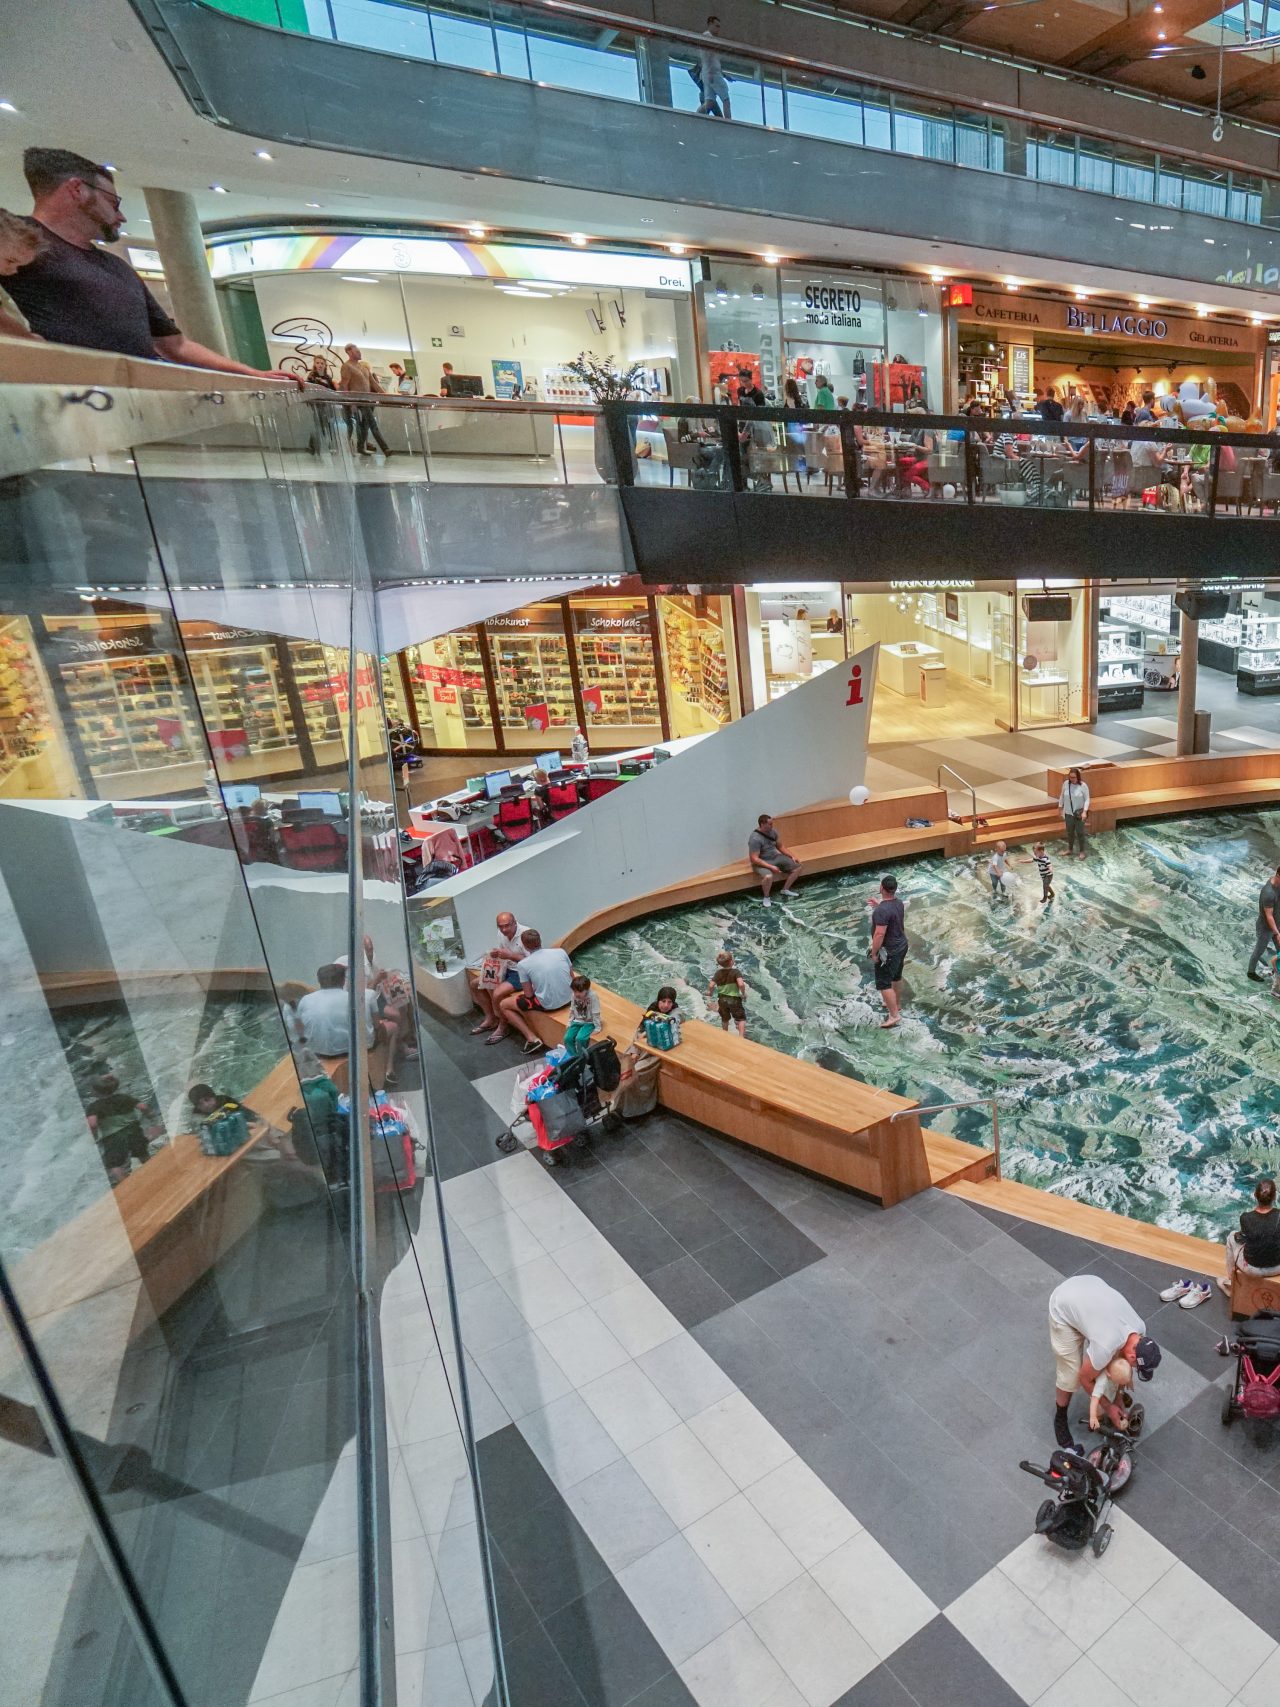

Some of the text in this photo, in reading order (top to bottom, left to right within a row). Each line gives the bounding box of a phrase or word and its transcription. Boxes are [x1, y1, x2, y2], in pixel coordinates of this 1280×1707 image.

[659, 275, 685, 287] Drei.
[805, 285, 861, 312] SEGRETO
[831, 313, 862, 328] italiana
